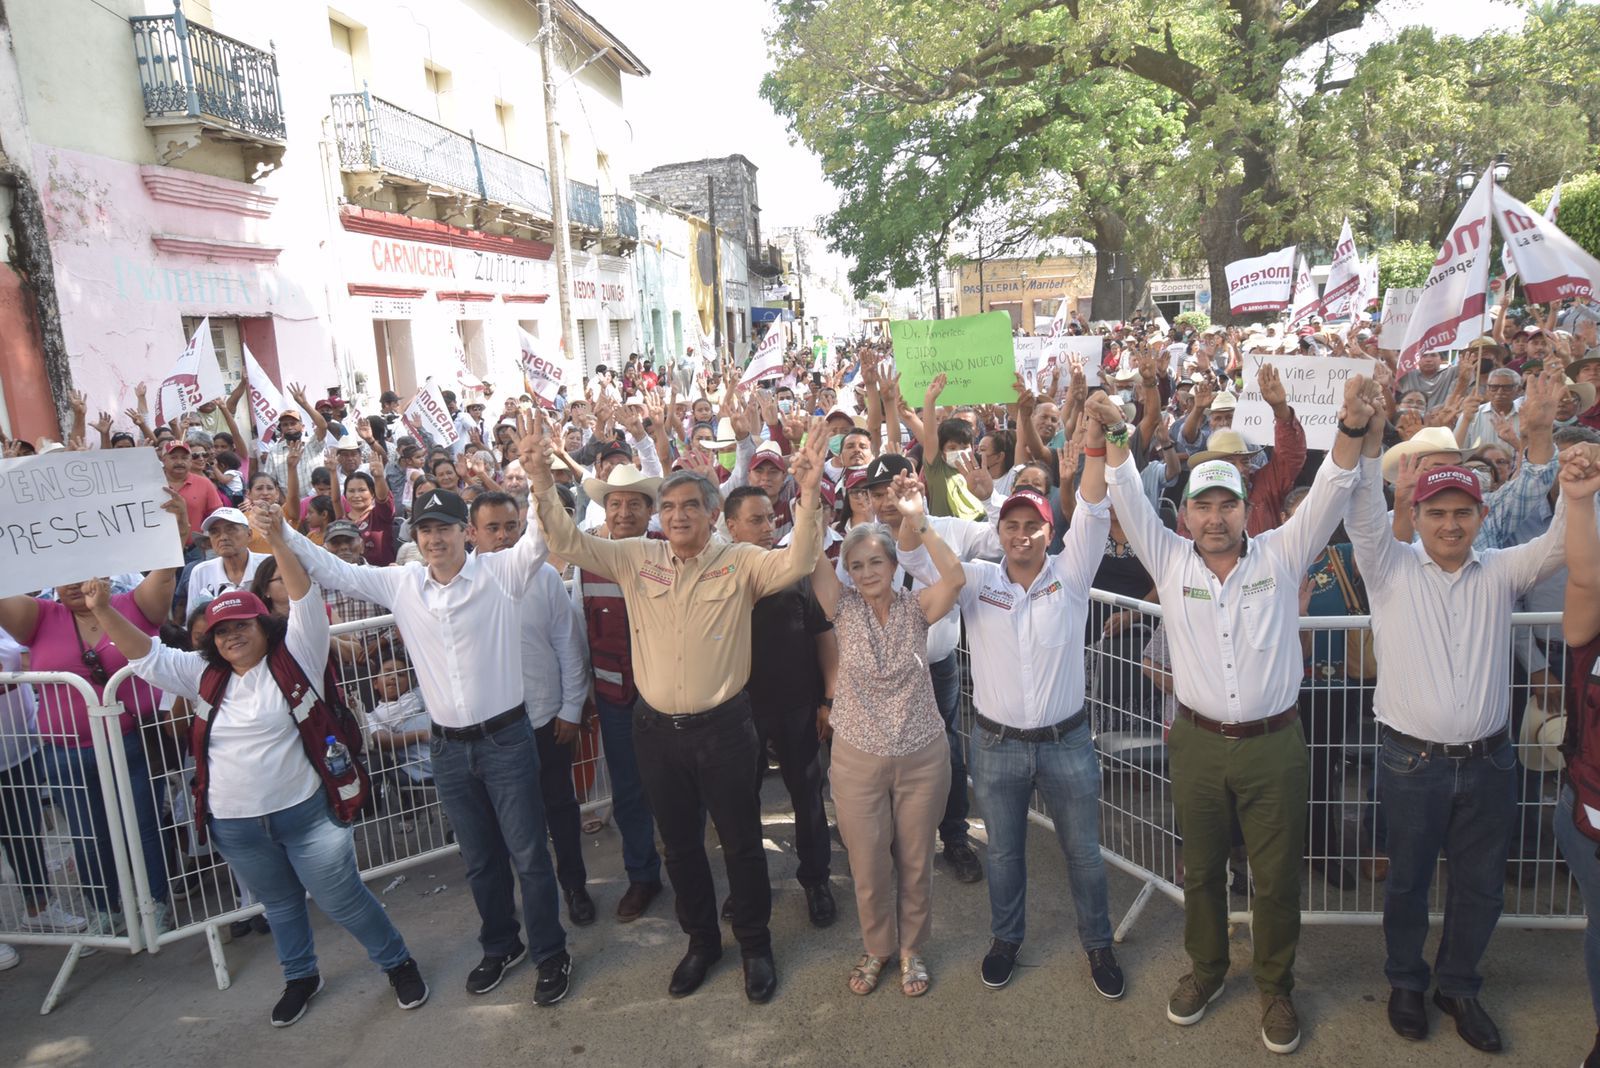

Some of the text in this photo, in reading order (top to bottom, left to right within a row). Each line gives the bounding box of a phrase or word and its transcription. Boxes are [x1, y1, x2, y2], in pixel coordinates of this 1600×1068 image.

[372, 239, 456, 279] CARNICERIA
[963, 282, 1019, 294] PASTELERIA
[906, 345, 938, 360] EJIDO
[521, 348, 563, 381] orena
[967, 354, 1004, 370] NUEVO
[1285, 367, 1316, 380] vine
[1326, 368, 1351, 389] por
[1286, 384, 1335, 405] oluntad
[418, 389, 460, 442] morena
[1244, 414, 1262, 426] no
[1427, 471, 1473, 483] morena
[211, 598, 242, 613] morena
